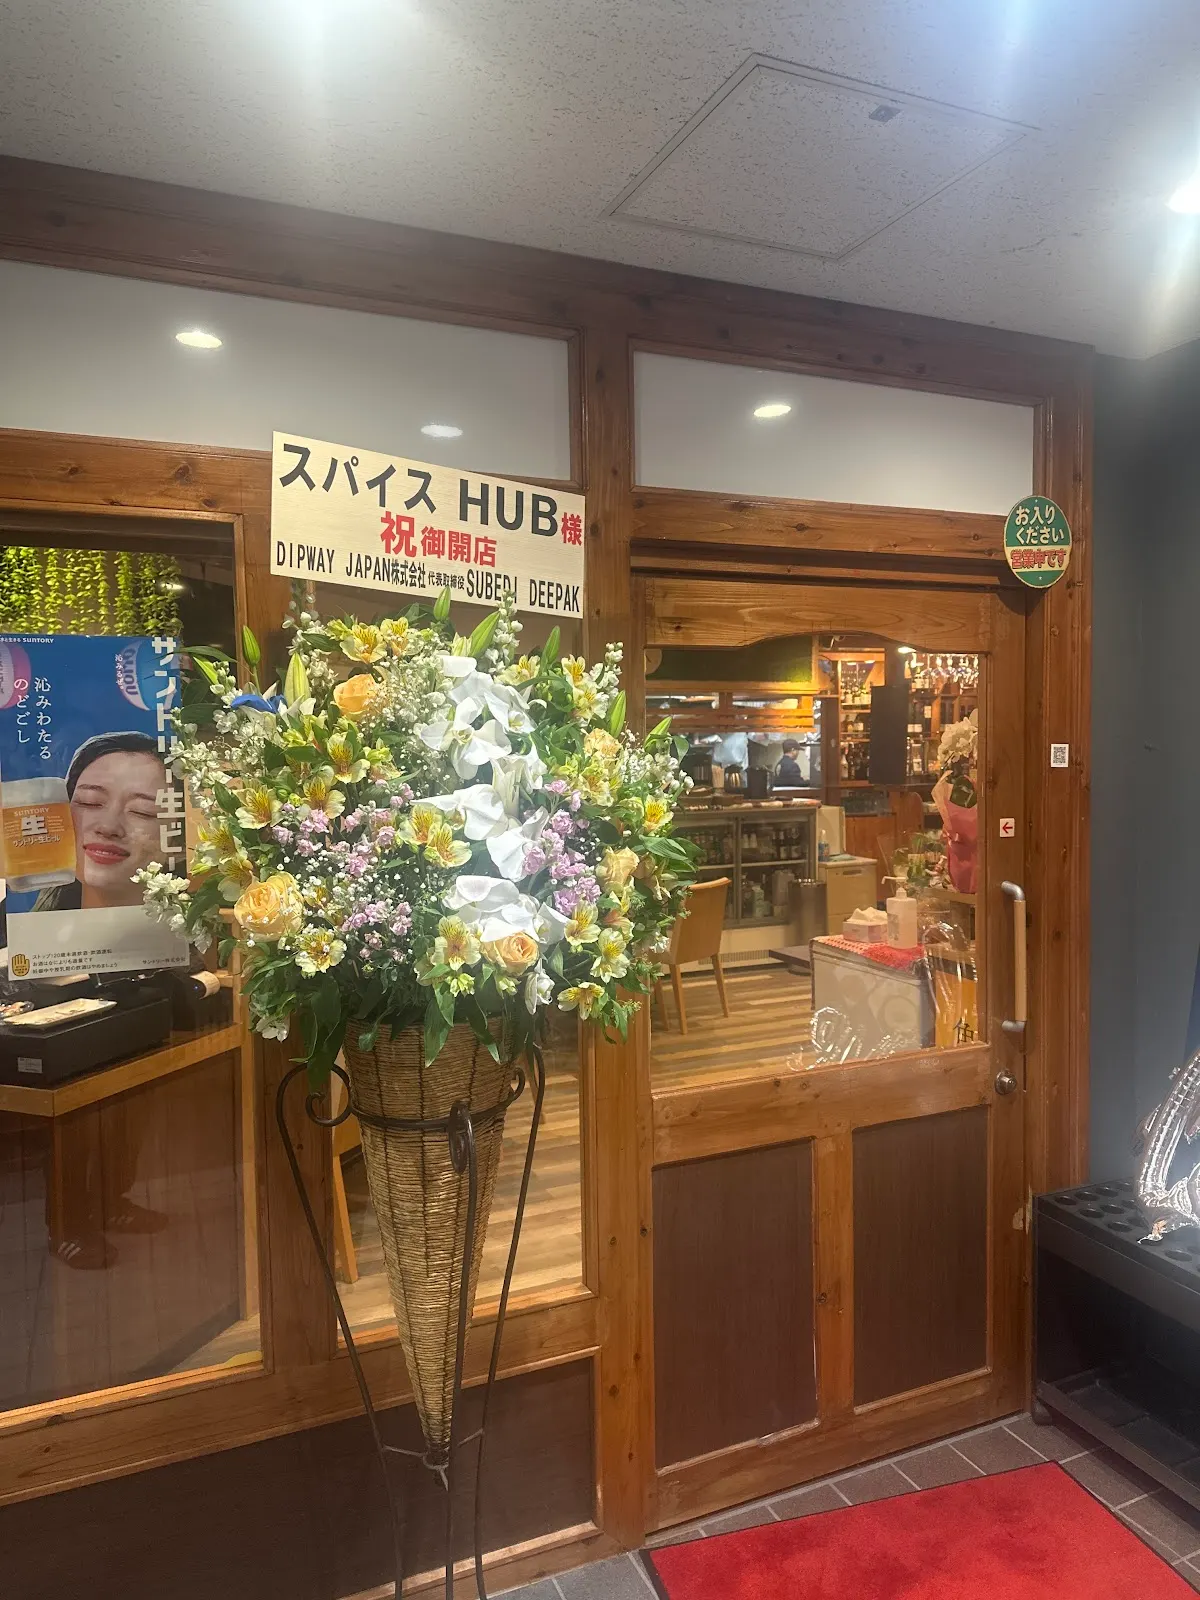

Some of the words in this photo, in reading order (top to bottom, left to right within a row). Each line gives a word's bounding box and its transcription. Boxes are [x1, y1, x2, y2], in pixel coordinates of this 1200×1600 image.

[279, 443, 437, 514] スパイス
[1015, 504, 1055, 525] お入り
[1016, 525, 1064, 545] ください
[1011, 549, 1066, 570] 営業中です
[276, 540, 335, 574] DIPWAY
[529, 578, 580, 612] DEEPAK
[13, 678, 31, 743] のどごし
[34, 677, 52, 760] 沁みわたる
[14, 808, 49, 817] SUNTORY
[22, 815, 48, 837] 生
